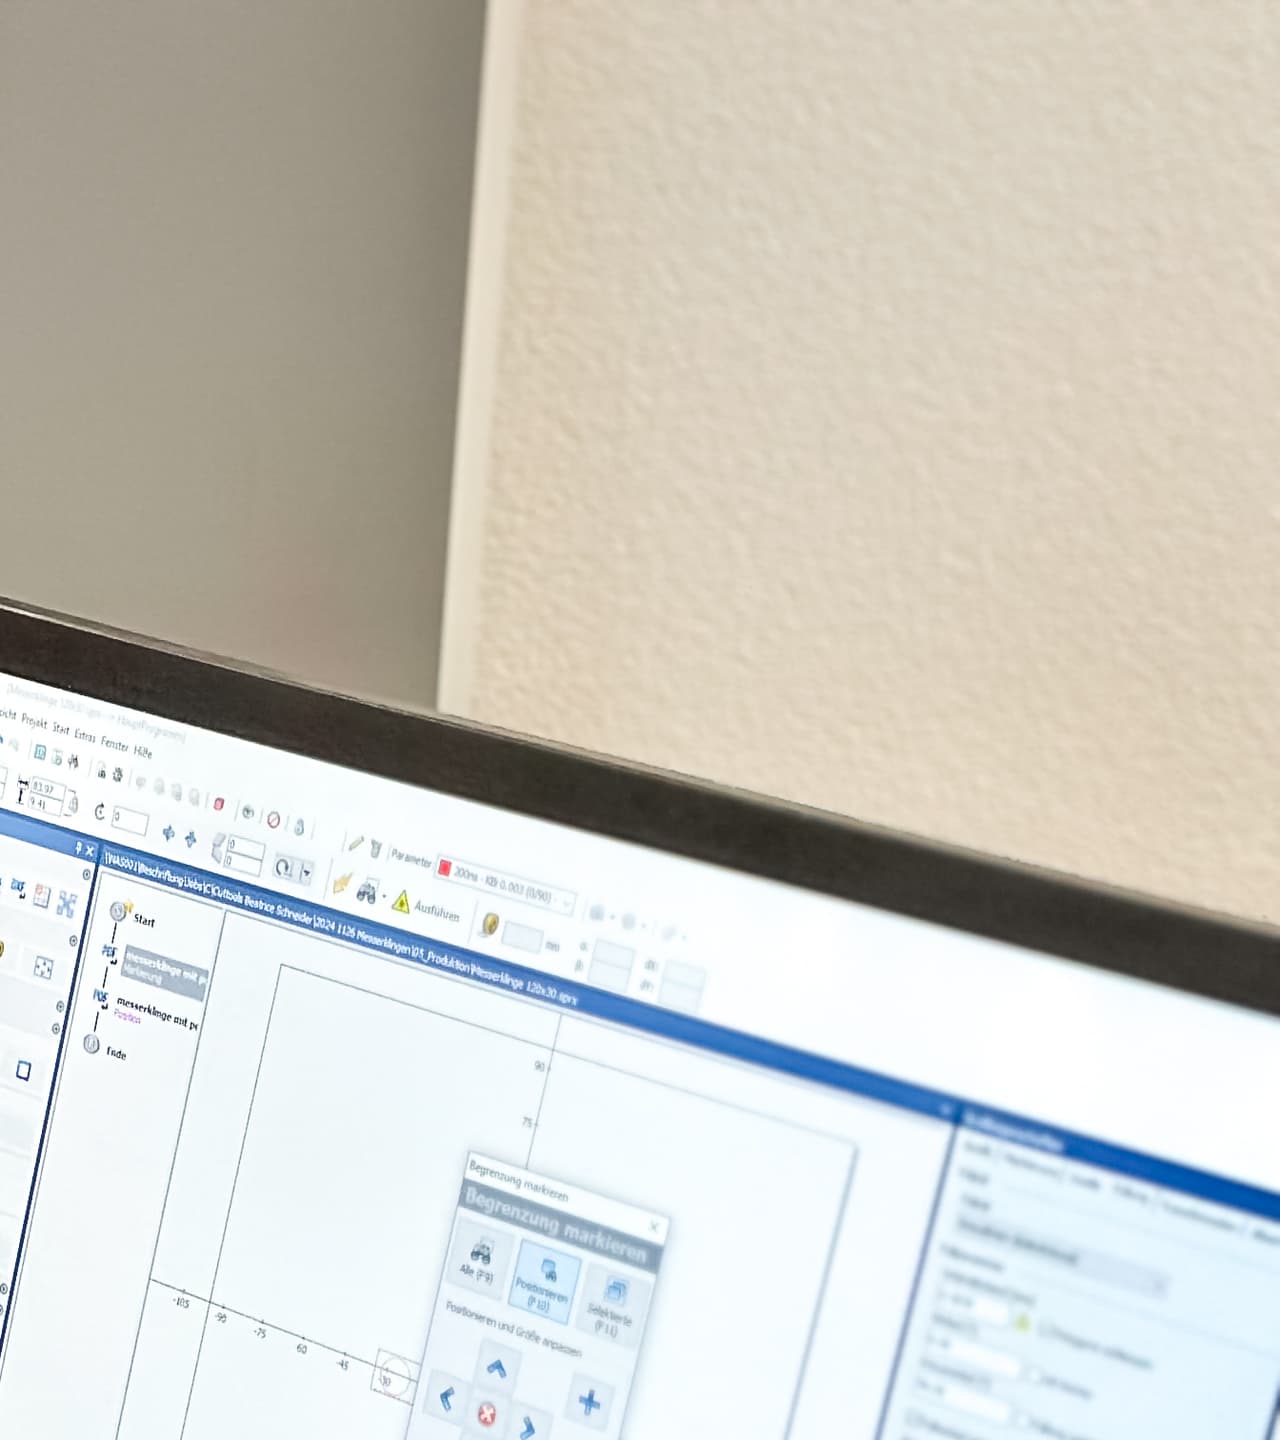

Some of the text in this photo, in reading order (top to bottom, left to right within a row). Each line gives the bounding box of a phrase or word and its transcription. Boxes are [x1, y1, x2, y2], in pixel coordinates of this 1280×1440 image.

[21, 712, 47, 729] Projekt
[52, 721, 70, 735] Start
[101, 735, 128, 751] Fenster
[391, 848, 432, 868] Parameter
[134, 913, 155, 928] Start
[469, 1159, 568, 1201] Begrenzung markieren
[465, 1186, 647, 1263] Begrenzung markieren
[497, 1321, 515, 1334] und
